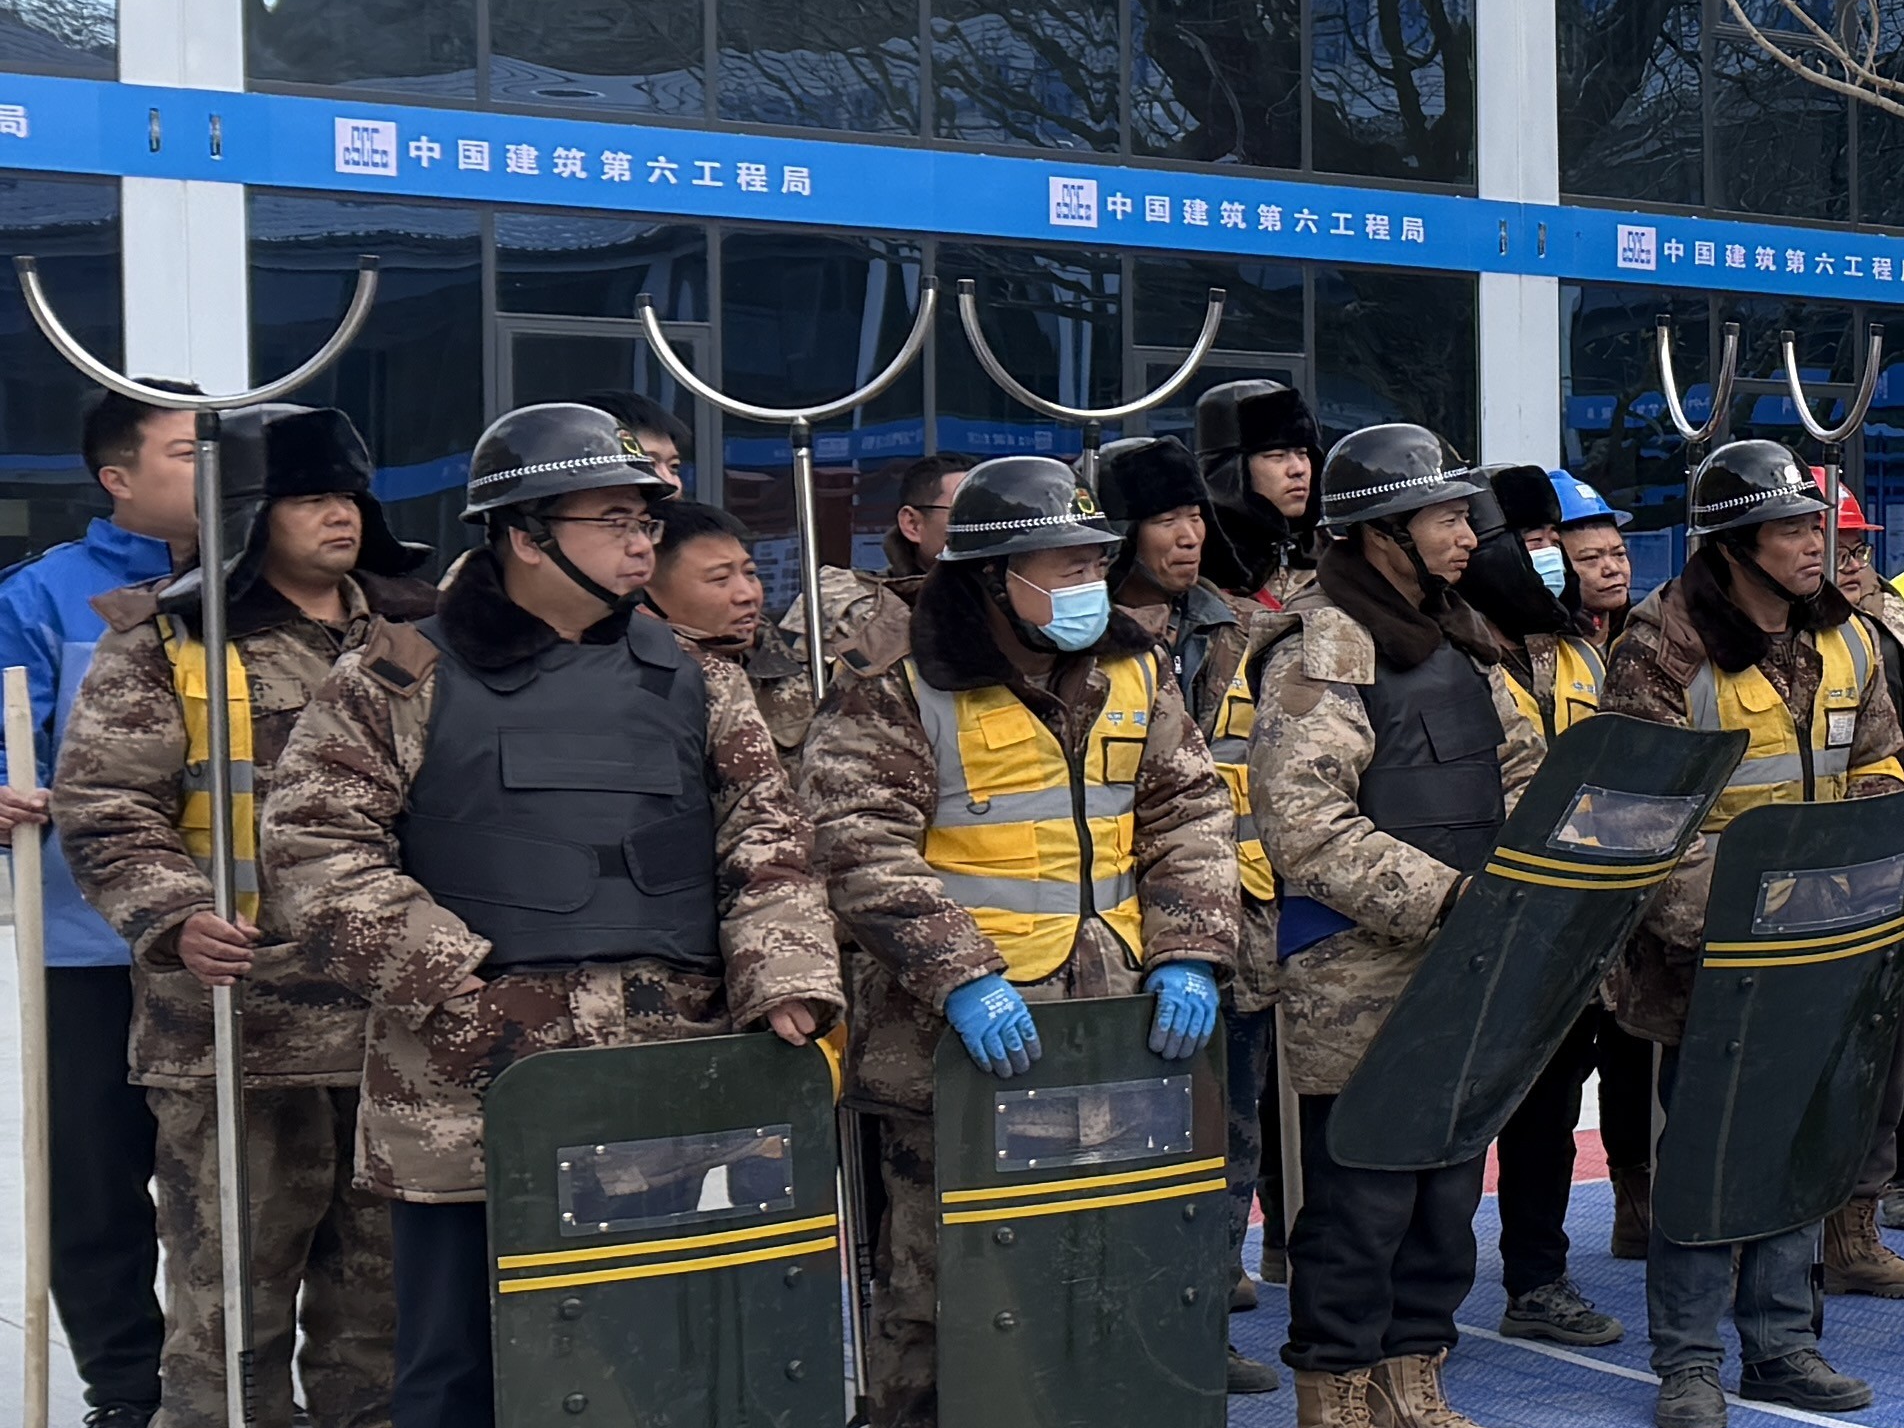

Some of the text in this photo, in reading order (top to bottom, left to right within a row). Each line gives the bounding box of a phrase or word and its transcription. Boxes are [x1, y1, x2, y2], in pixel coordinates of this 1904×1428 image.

[408, 135, 811, 196] 中国建筑第六工程局
[1106, 192, 1424, 243] 中国建筑第六工程局
